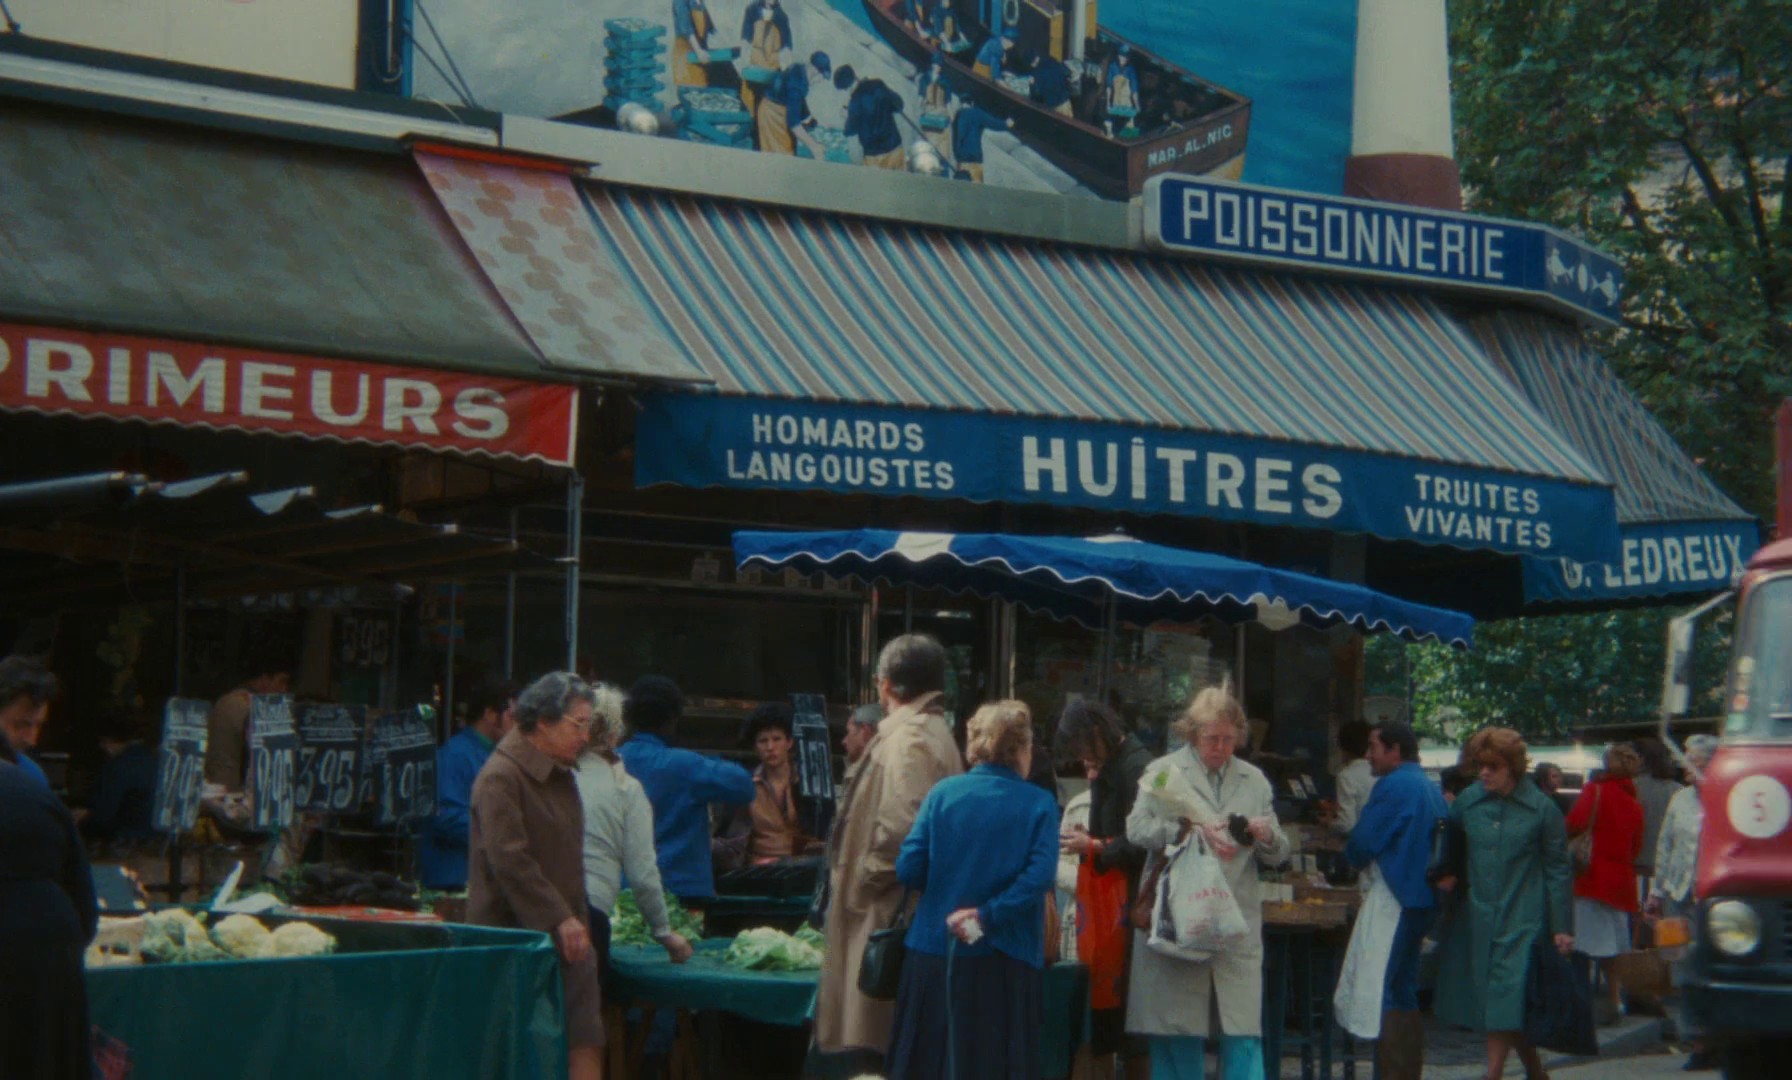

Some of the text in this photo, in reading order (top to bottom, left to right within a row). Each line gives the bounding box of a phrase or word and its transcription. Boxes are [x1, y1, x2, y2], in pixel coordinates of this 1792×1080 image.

[1183, 187, 1504, 280] POISSONNERIE
[0, 336, 510, 440] RIMEURS
[752, 413, 925, 452] HOMARDS
[727, 449, 955, 490] LANGOUSTES
[1022, 436, 1343, 519] HUÎTRES
[1414, 474, 1541, 515] TRUITES
[1404, 506, 1551, 548] VIVANTES
